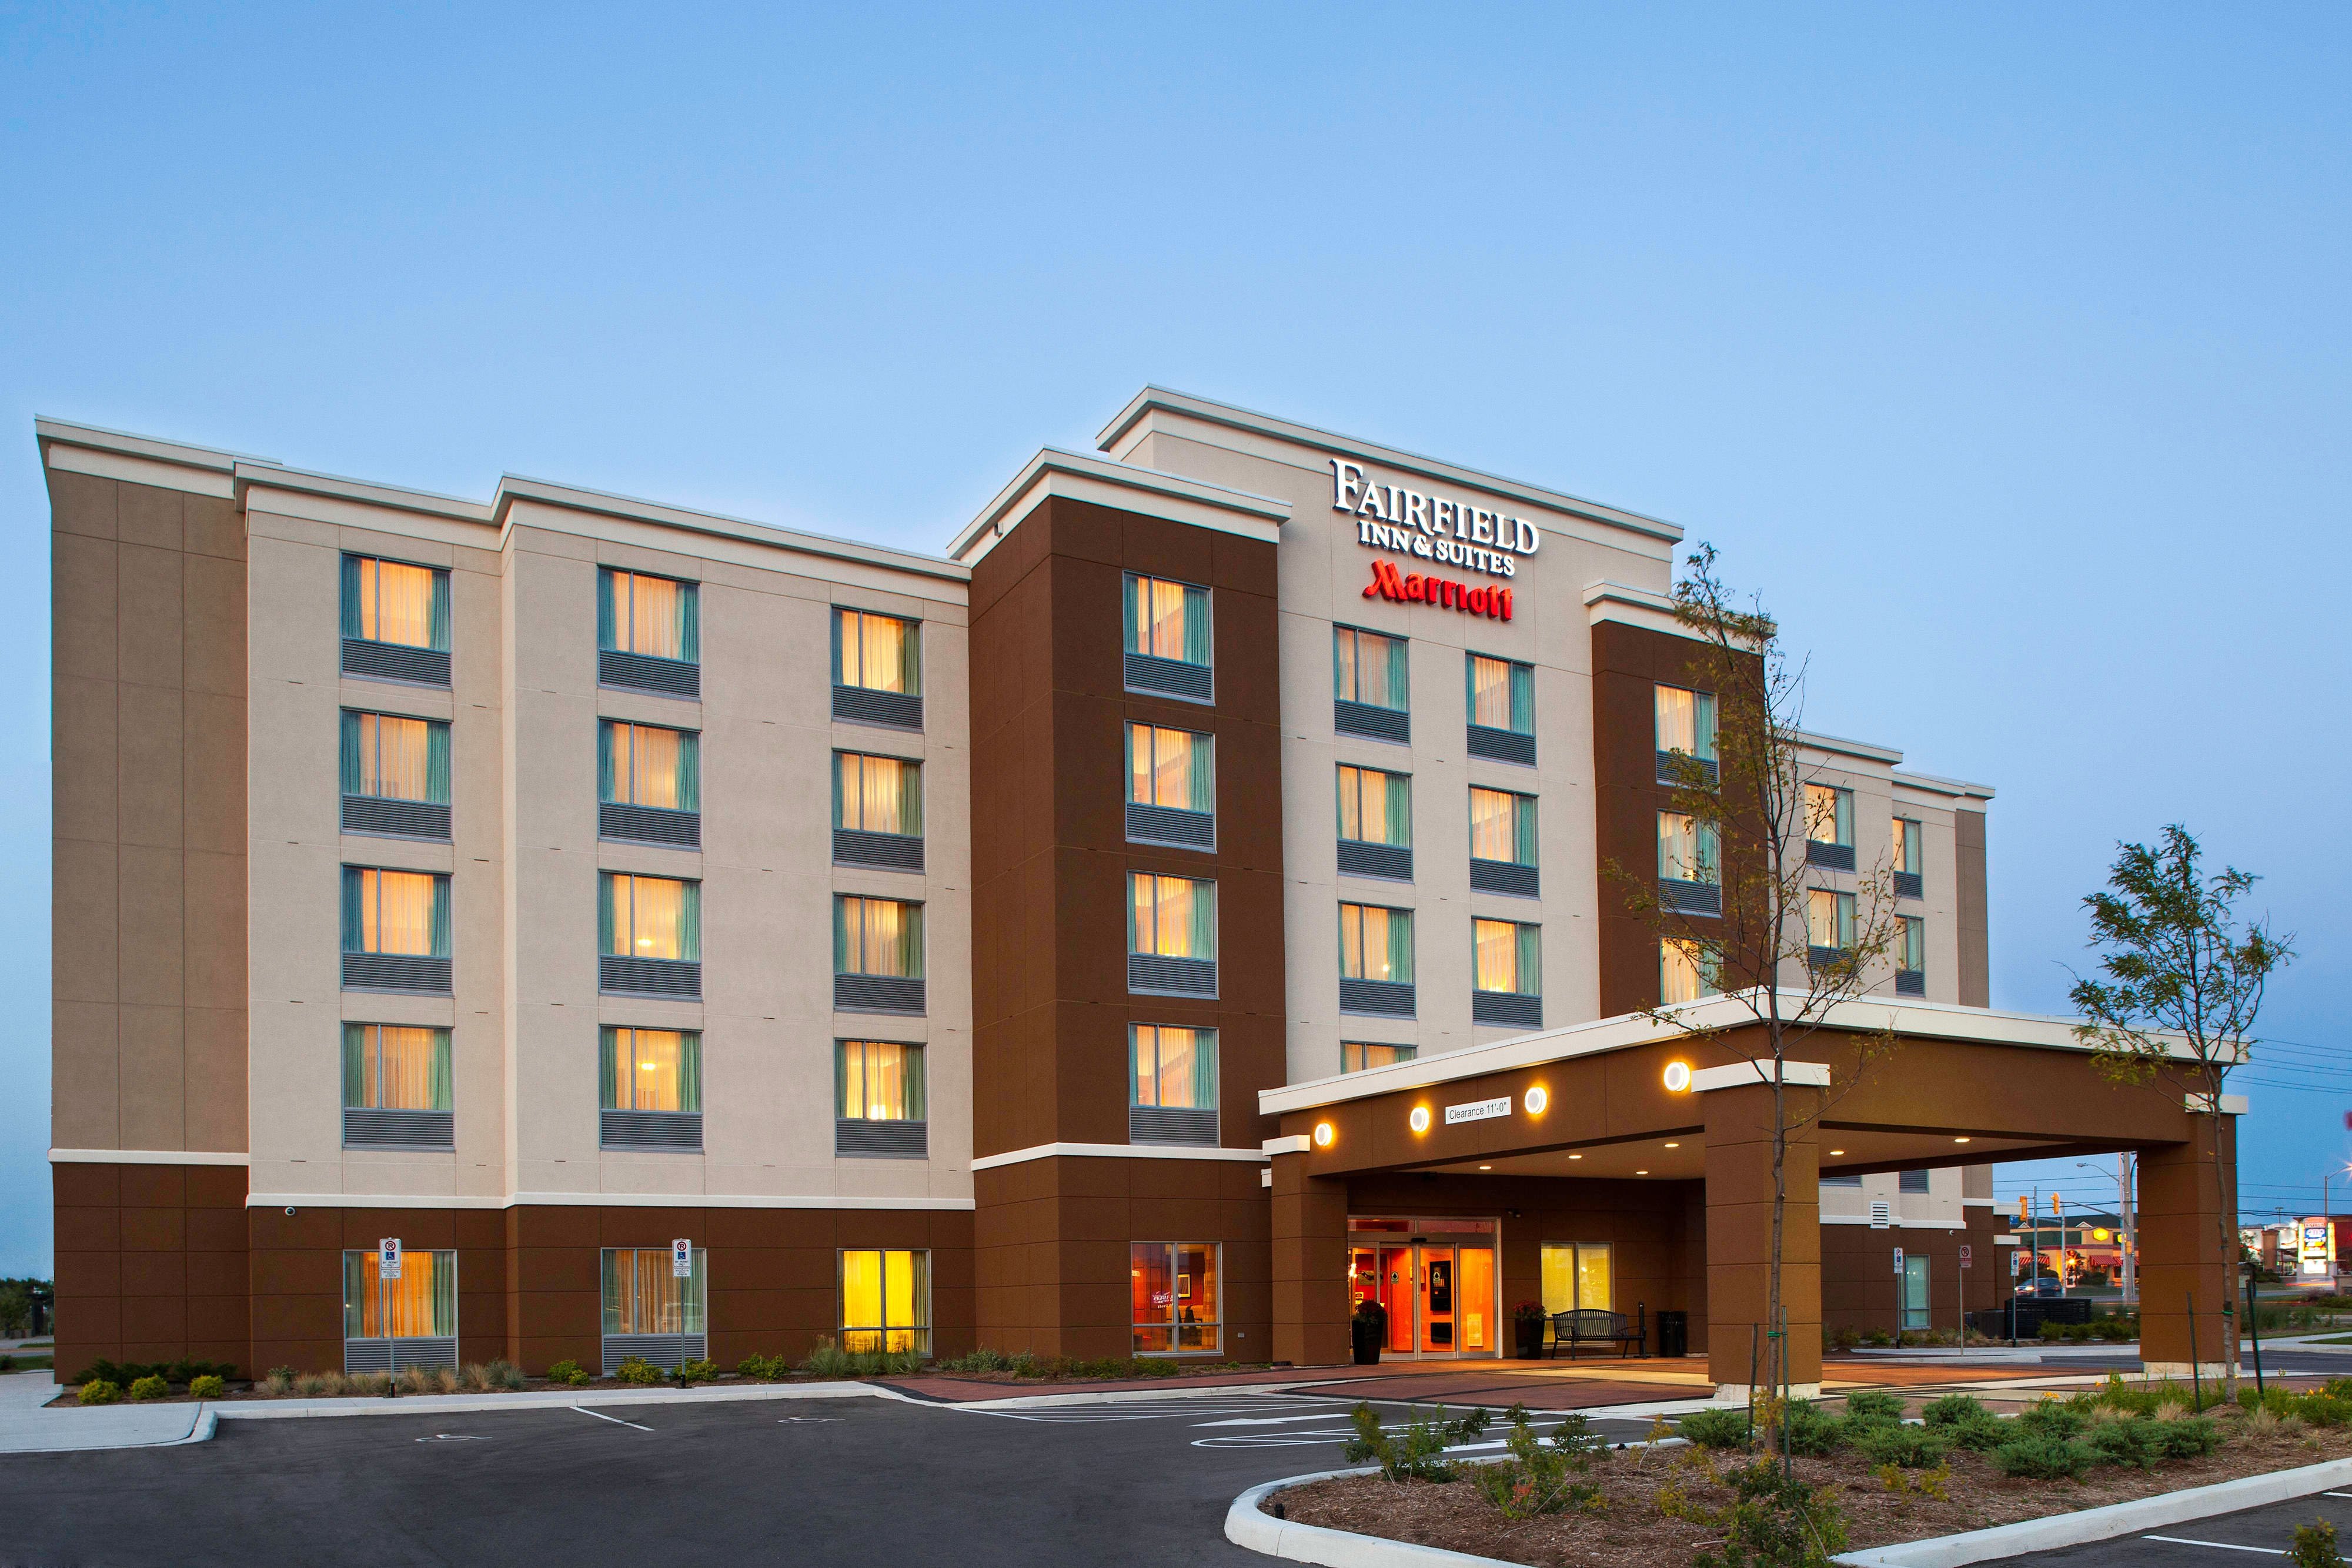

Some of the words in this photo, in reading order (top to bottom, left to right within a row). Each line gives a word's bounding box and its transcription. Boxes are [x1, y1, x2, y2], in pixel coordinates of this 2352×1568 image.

[1329, 458, 1540, 554] FAIRFIELD
[1362, 558, 1513, 621] Marriott
[1449, 1107, 1484, 1119] Clearance
[1486, 1102, 1507, 1114] 11'-0"
